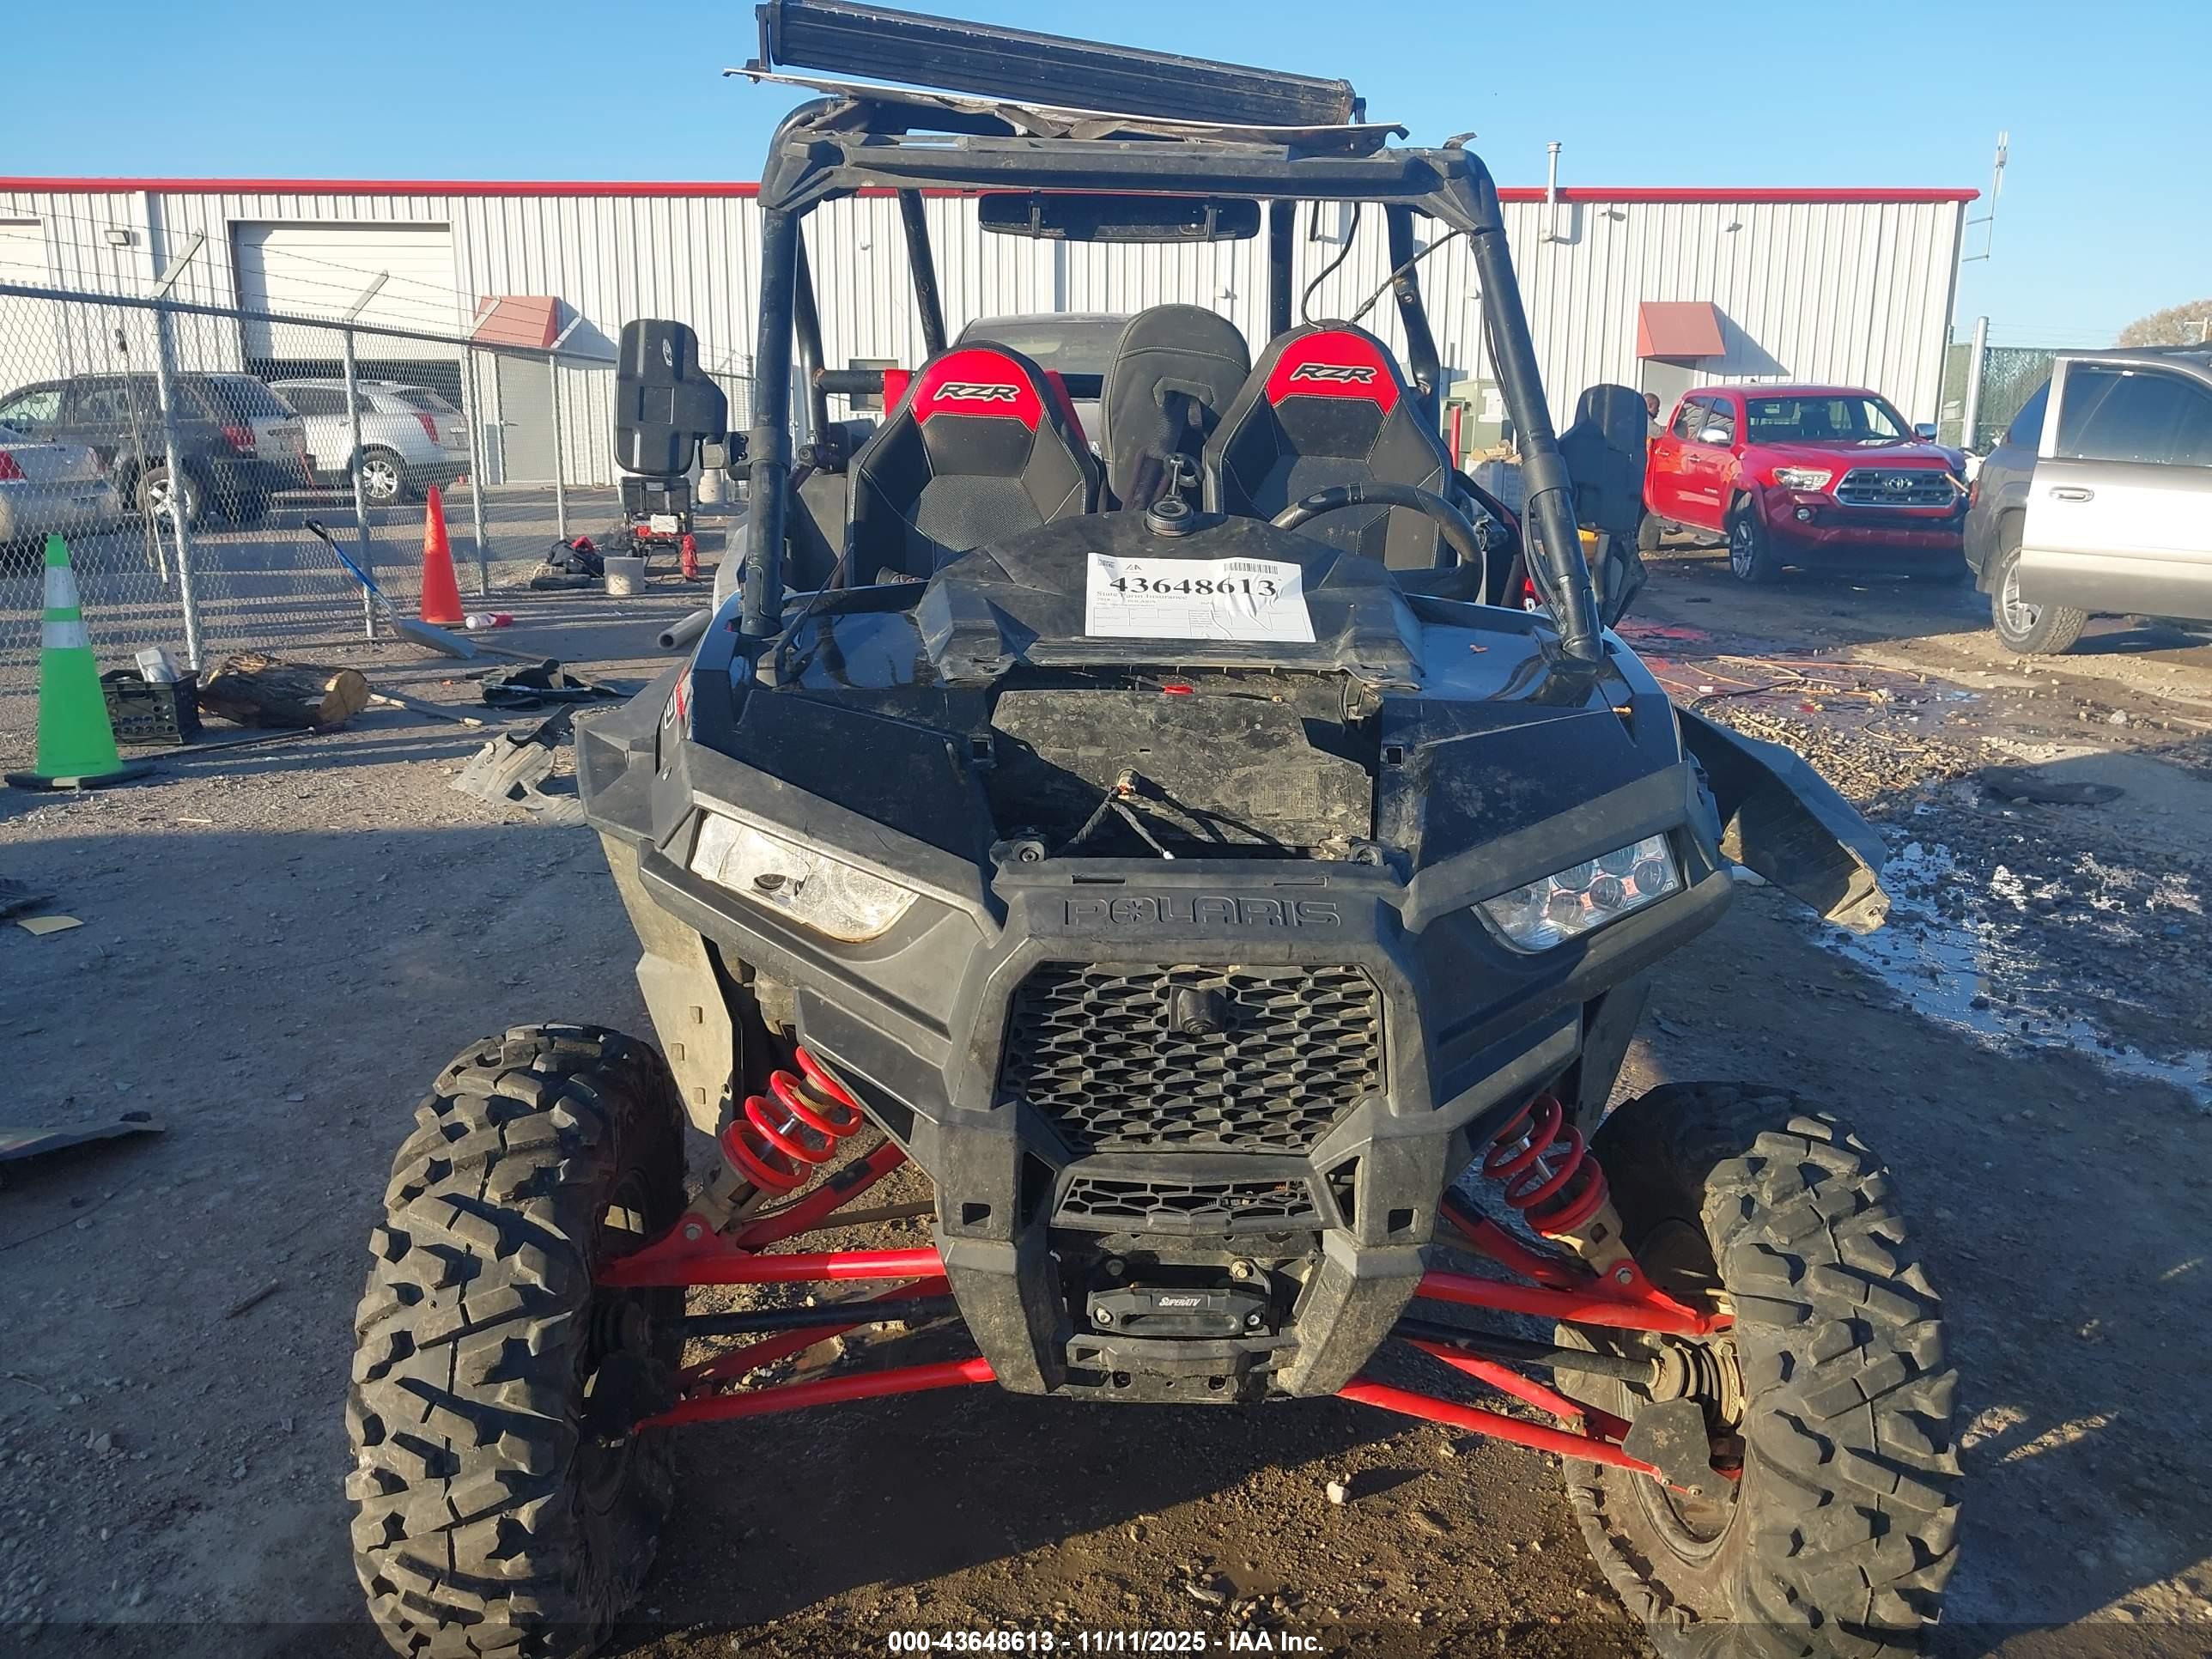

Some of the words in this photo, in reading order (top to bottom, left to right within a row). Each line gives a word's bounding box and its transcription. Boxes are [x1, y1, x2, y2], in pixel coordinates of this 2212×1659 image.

[1288, 363, 1377, 385] RZR
[934, 381, 1020, 404] RZR
[1109, 576, 1277, 598] 43648613
[1064, 896, 1341, 927] POLARIS
